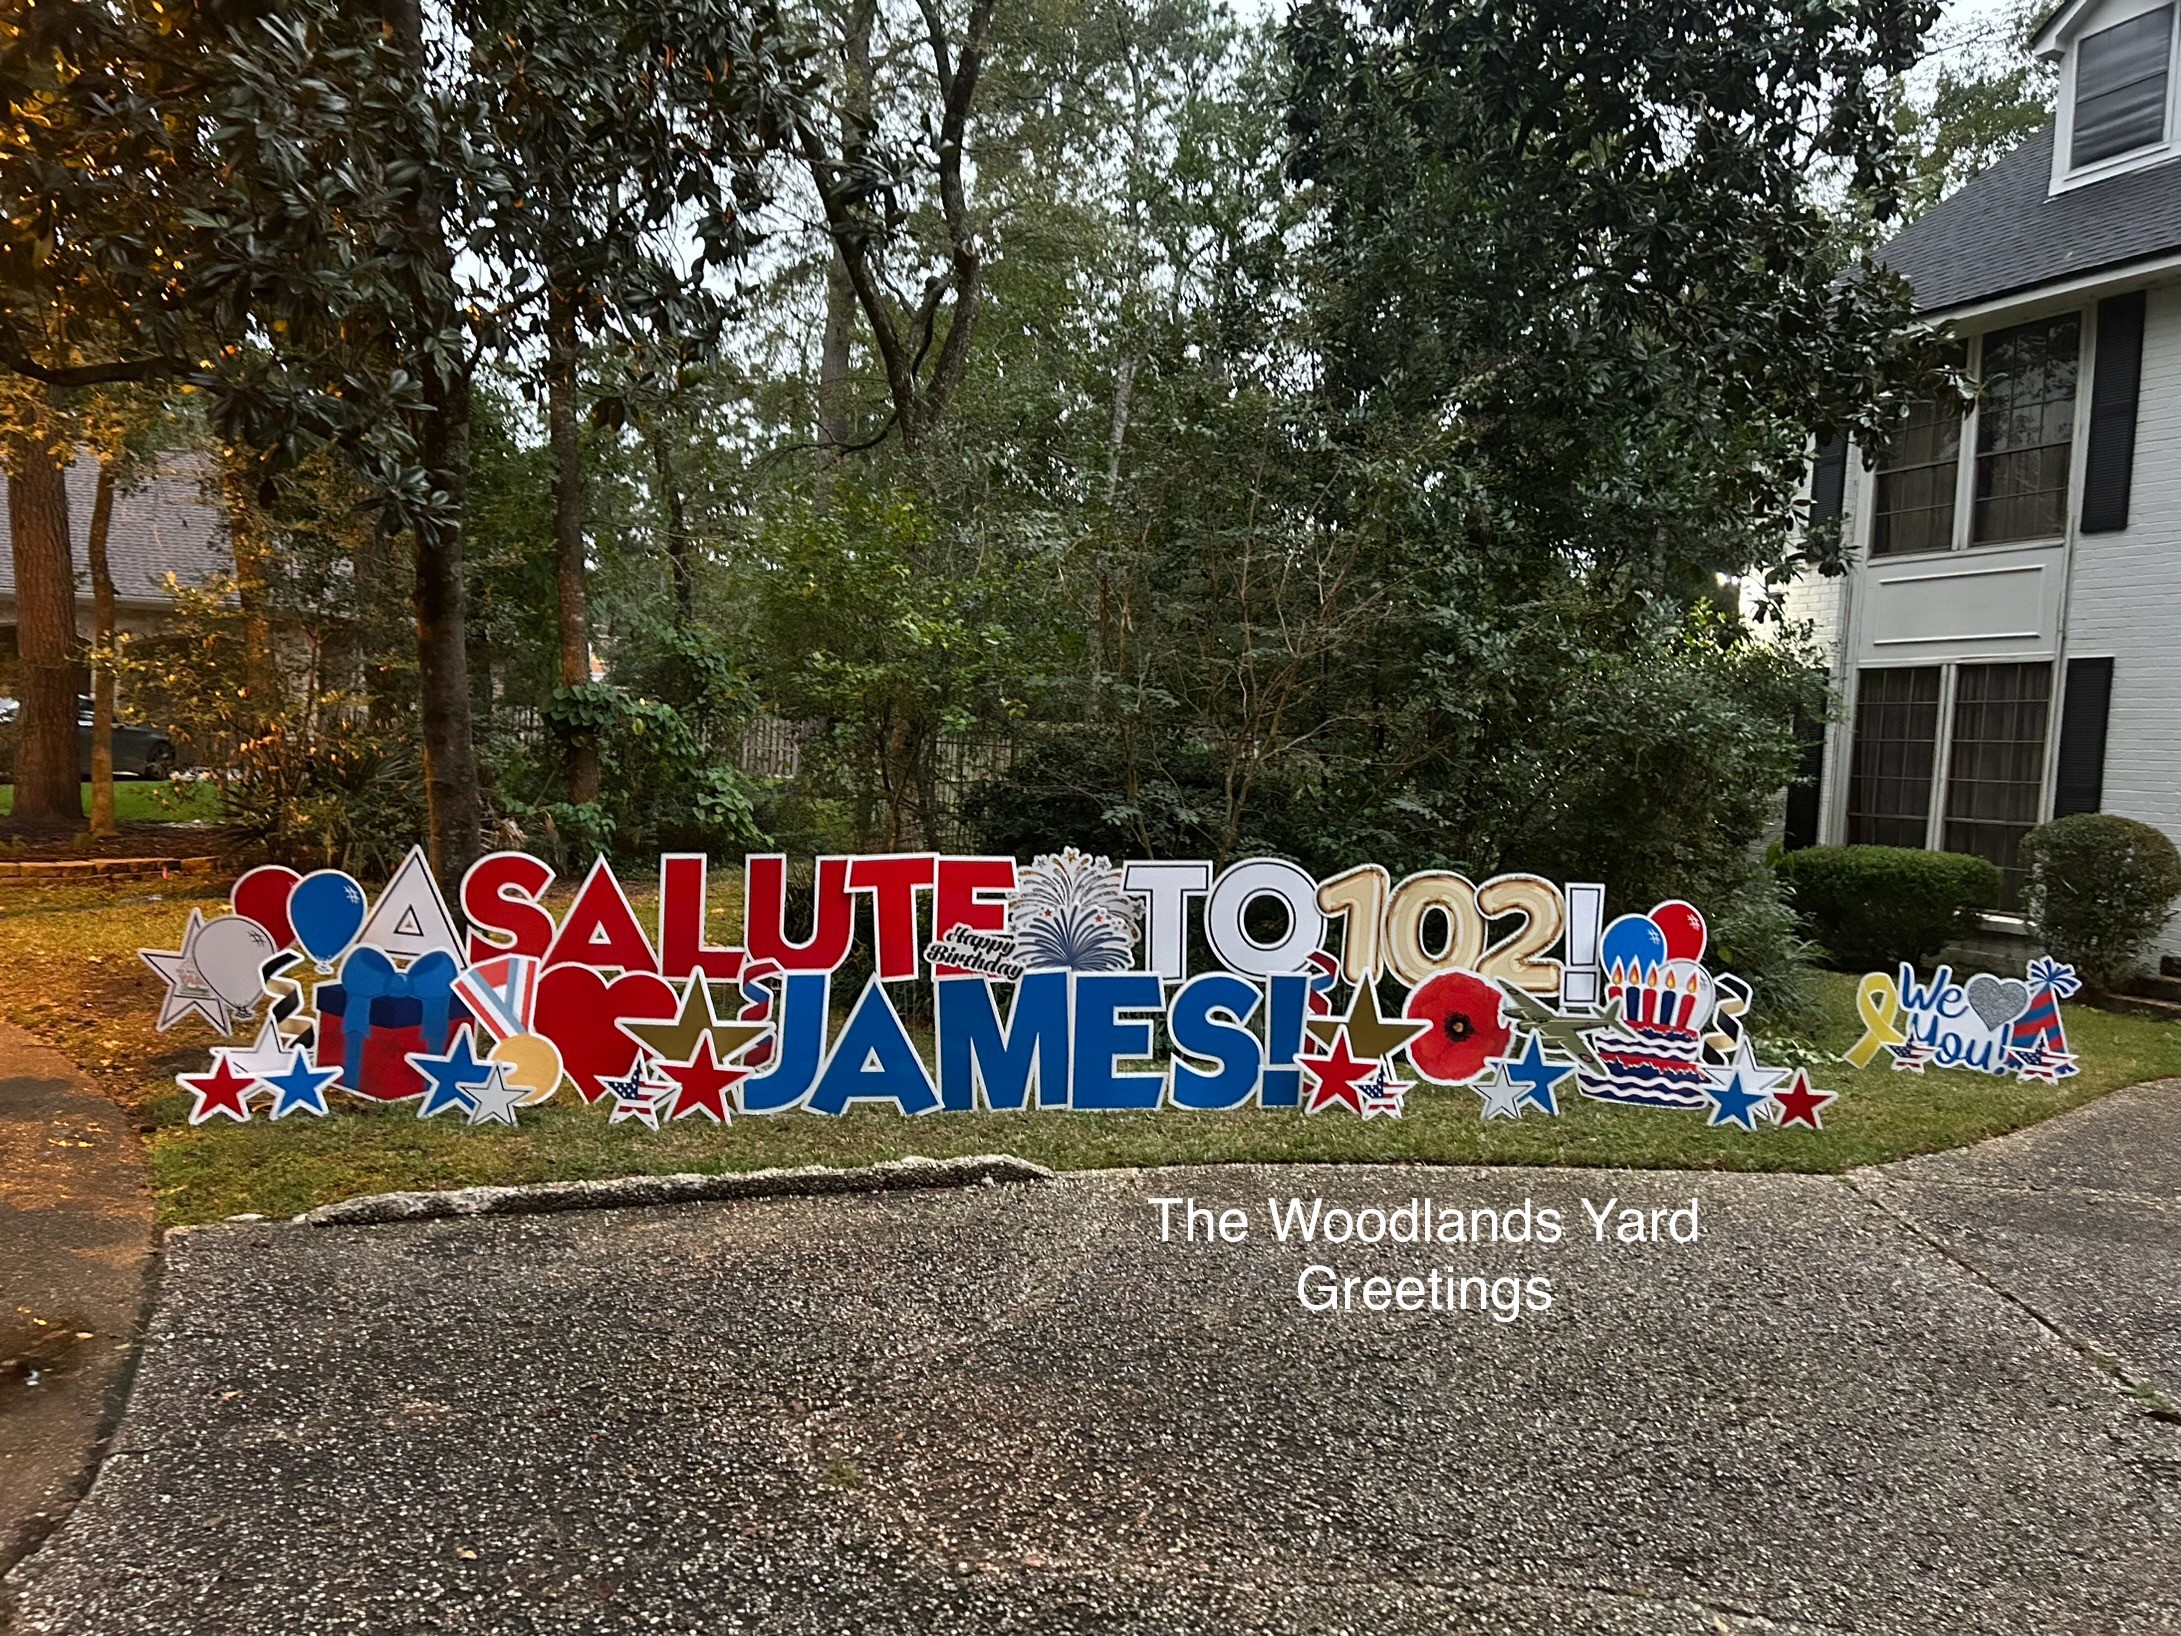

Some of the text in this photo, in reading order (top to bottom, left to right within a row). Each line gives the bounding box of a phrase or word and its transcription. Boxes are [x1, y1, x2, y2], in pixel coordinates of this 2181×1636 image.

[358, 845, 1605, 1005] A SALUTE TO 102!
[947, 924, 1016, 957] Happy
[926, 944, 1024, 981] Birthday
[1901, 962, 1970, 1019] We
[734, 967, 1312, 1116] JAMES!
[1910, 1012, 2010, 1077] You!
